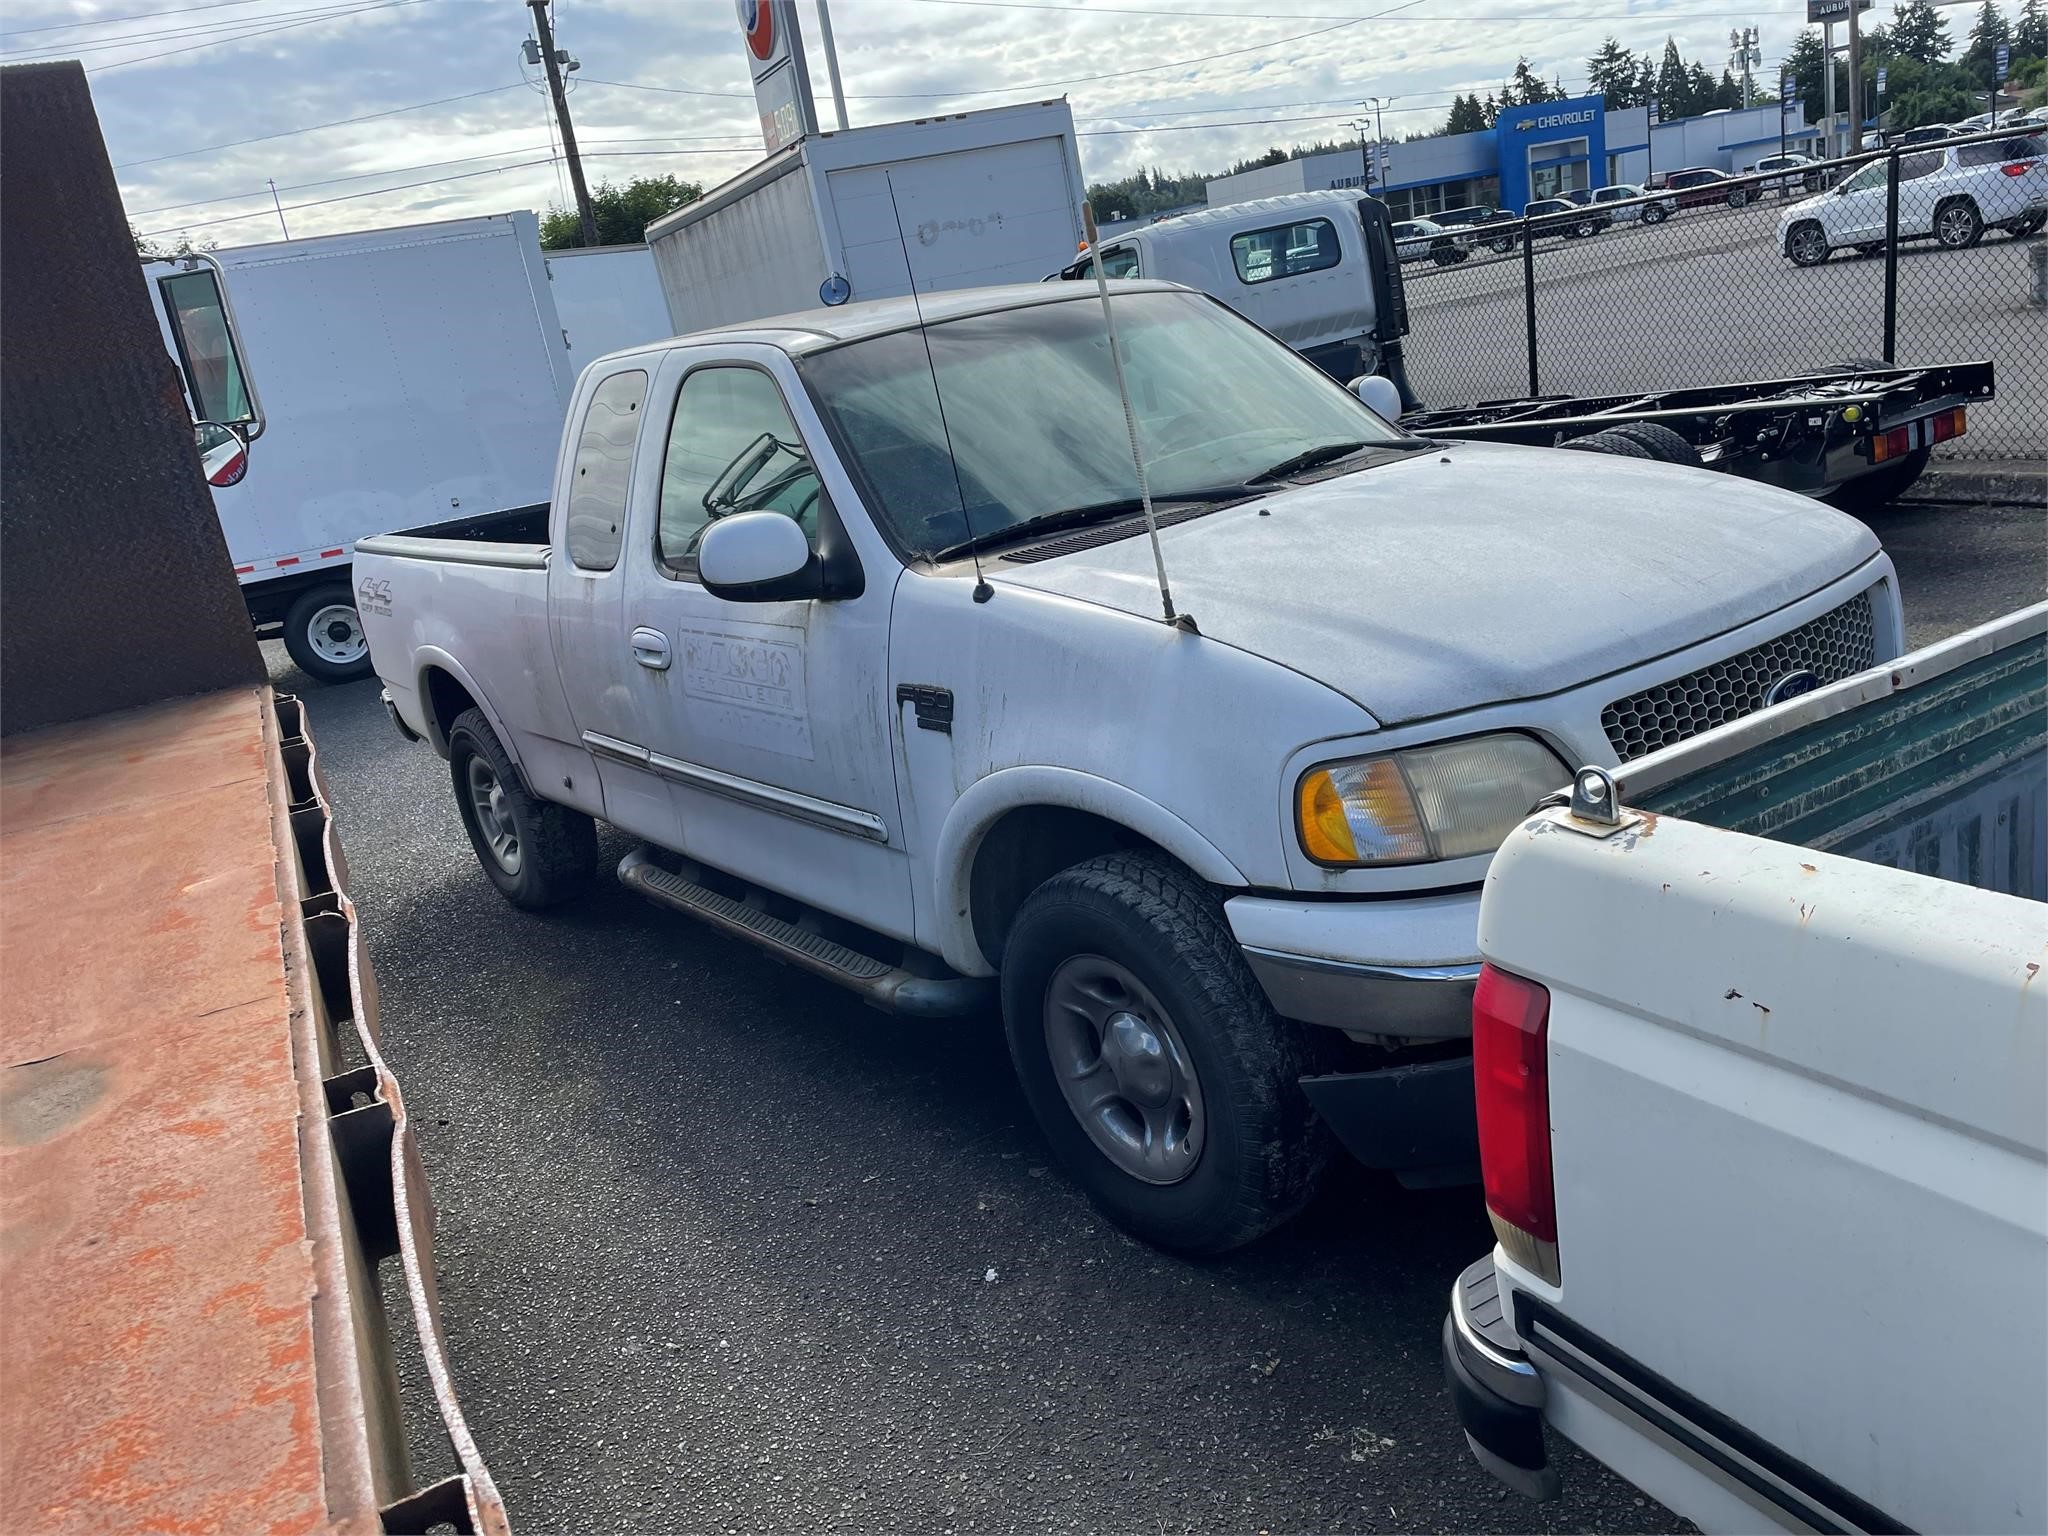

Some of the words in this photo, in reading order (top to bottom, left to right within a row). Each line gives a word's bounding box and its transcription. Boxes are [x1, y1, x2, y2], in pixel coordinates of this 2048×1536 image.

[1820, 1, 1850, 15] AUBUR
[1538, 109, 1596, 129] CHEVROLET
[1330, 175, 1367, 190] AUBUR
